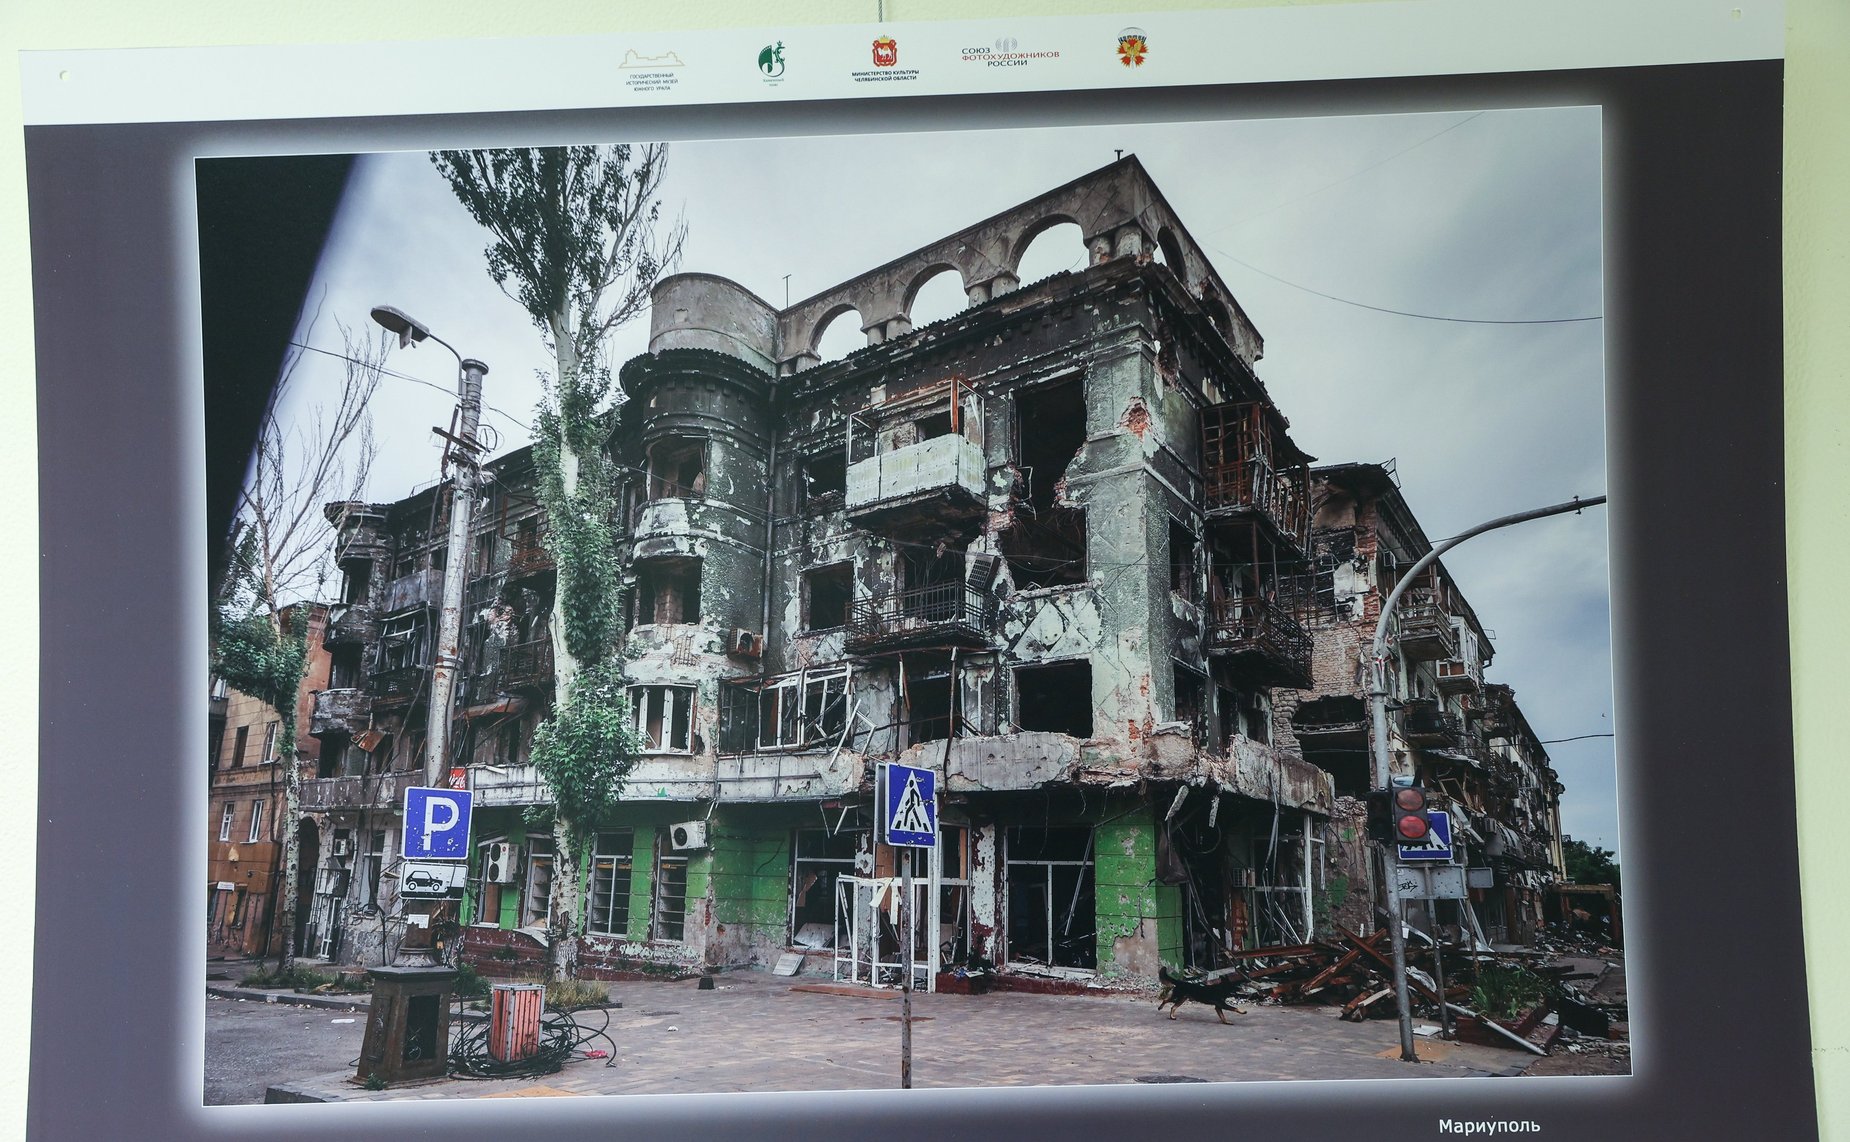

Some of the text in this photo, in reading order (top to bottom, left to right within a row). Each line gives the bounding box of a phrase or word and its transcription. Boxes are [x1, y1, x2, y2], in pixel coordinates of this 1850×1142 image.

[961, 51, 1060, 61] ФОТОХУДОЖНИКОВ
[422, 796, 460, 851] P
[1439, 1118, 1541, 1137] Мариуполь
